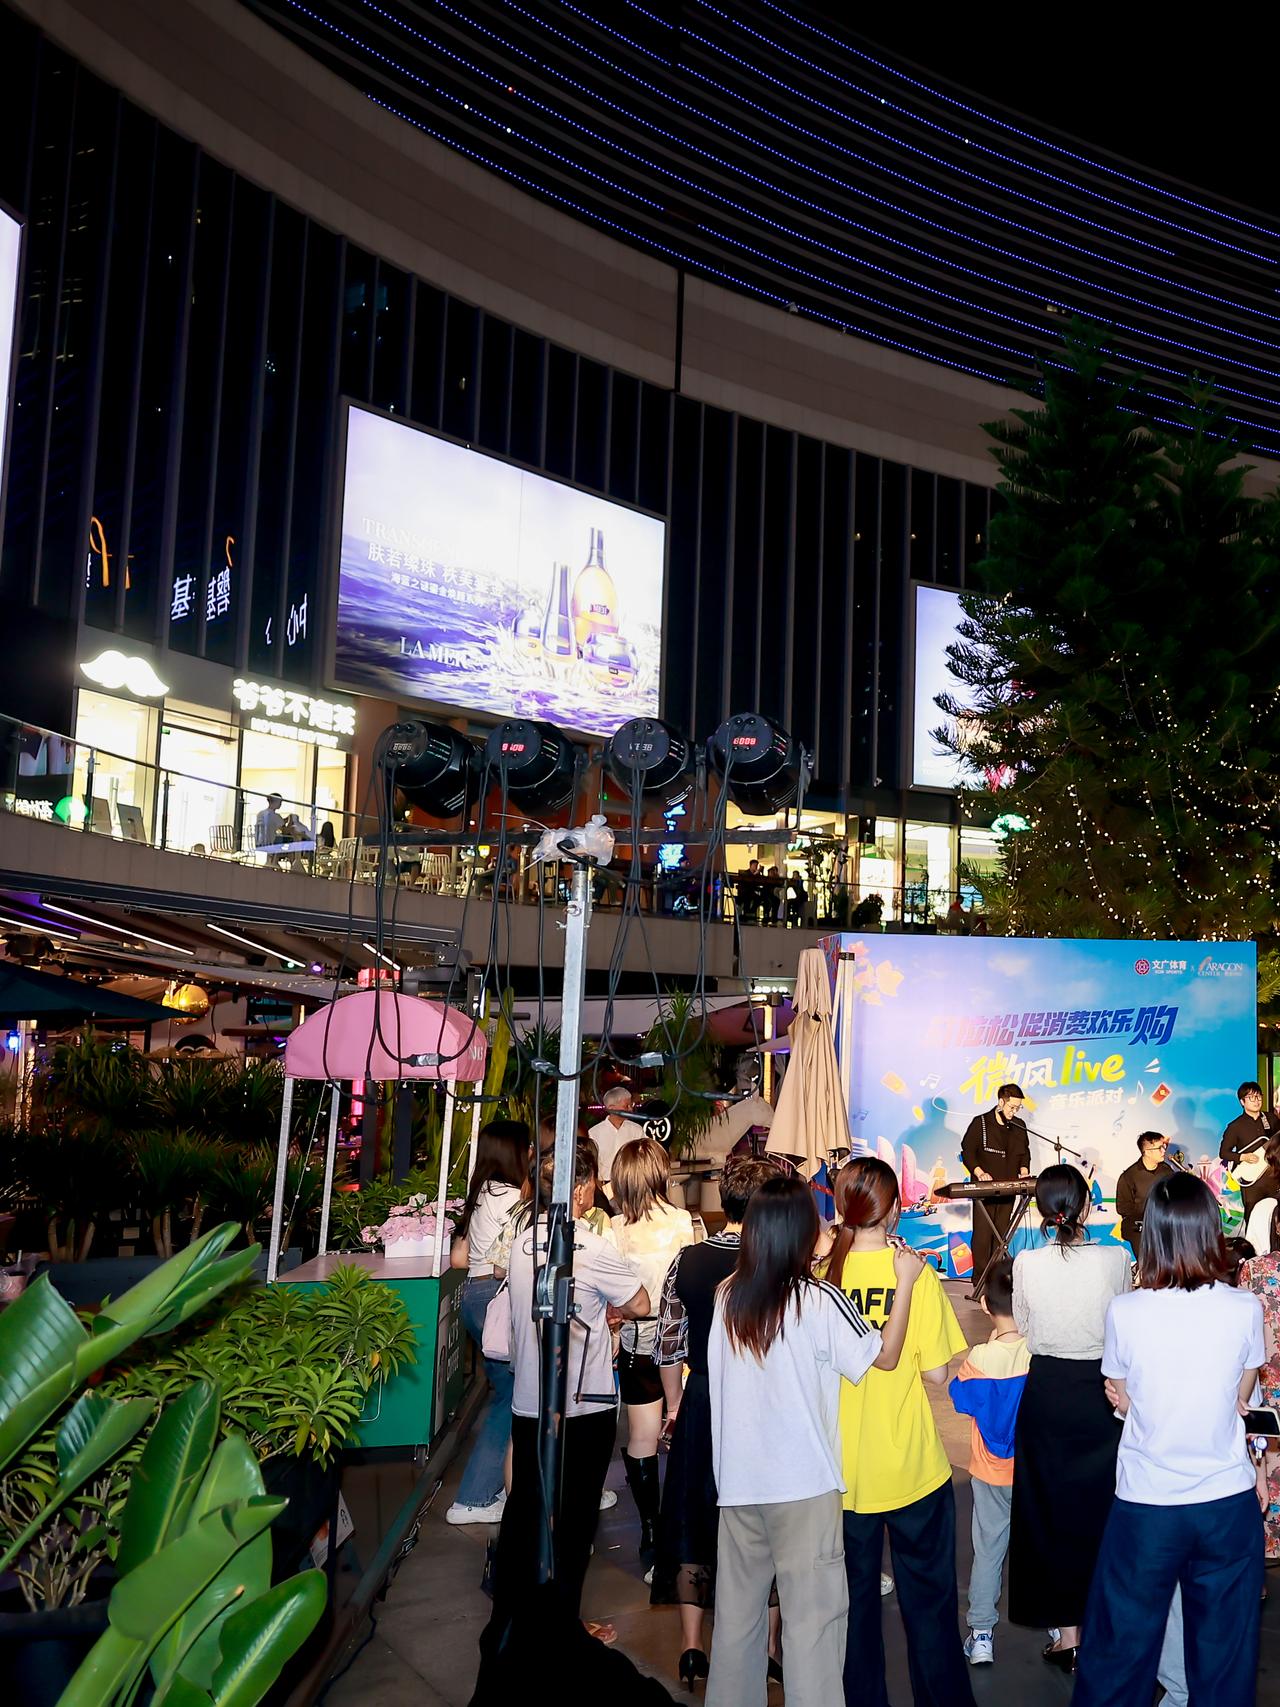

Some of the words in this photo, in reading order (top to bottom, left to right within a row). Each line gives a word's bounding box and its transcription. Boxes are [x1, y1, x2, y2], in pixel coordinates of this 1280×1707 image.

[1060, 1045, 1126, 1086] live
[1049, 1087, 1124, 1110] 音乐派对
